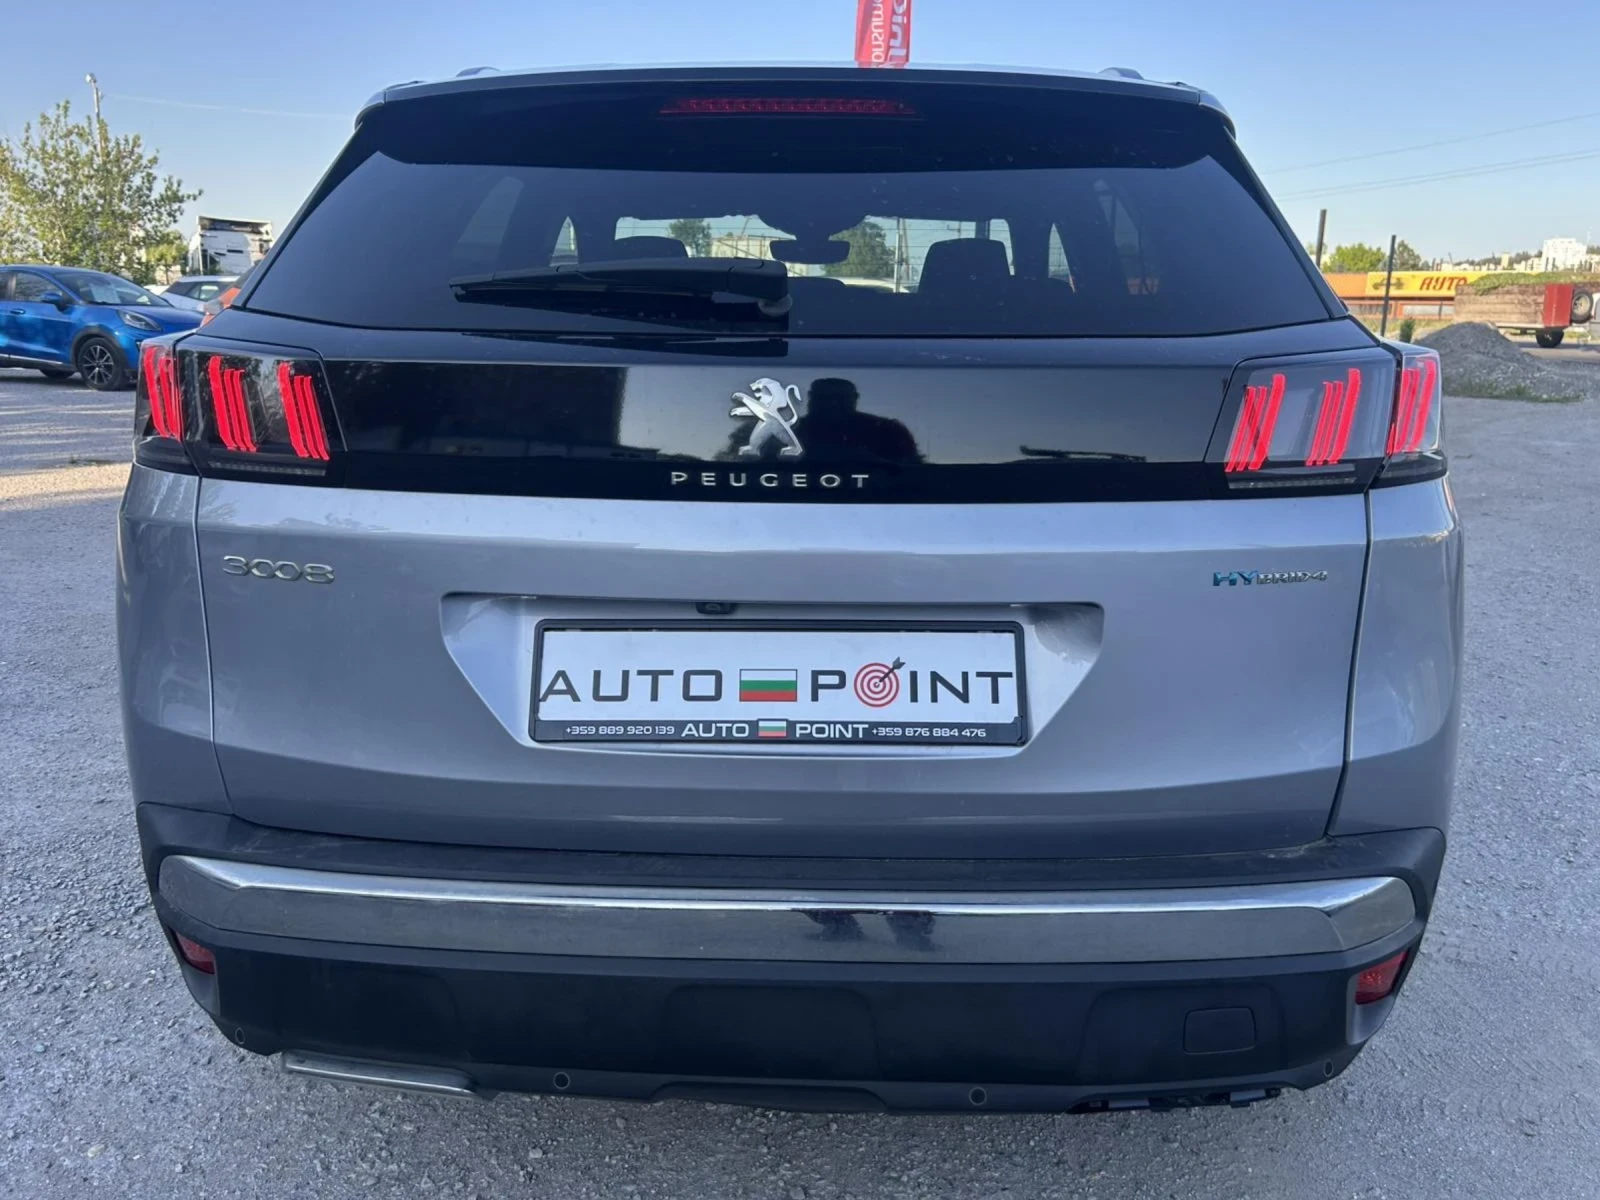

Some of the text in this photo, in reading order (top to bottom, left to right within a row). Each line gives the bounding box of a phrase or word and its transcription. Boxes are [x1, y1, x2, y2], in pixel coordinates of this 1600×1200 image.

[670, 471, 870, 489] PEUGEOT
[222, 555, 335, 584] 3008
[1212, 570, 1328, 587] HYBRID4
[538, 669, 724, 702] AUTO
[565, 722, 986, 739] +359 889 920 139 AUTO POINT +359 876 884 476
